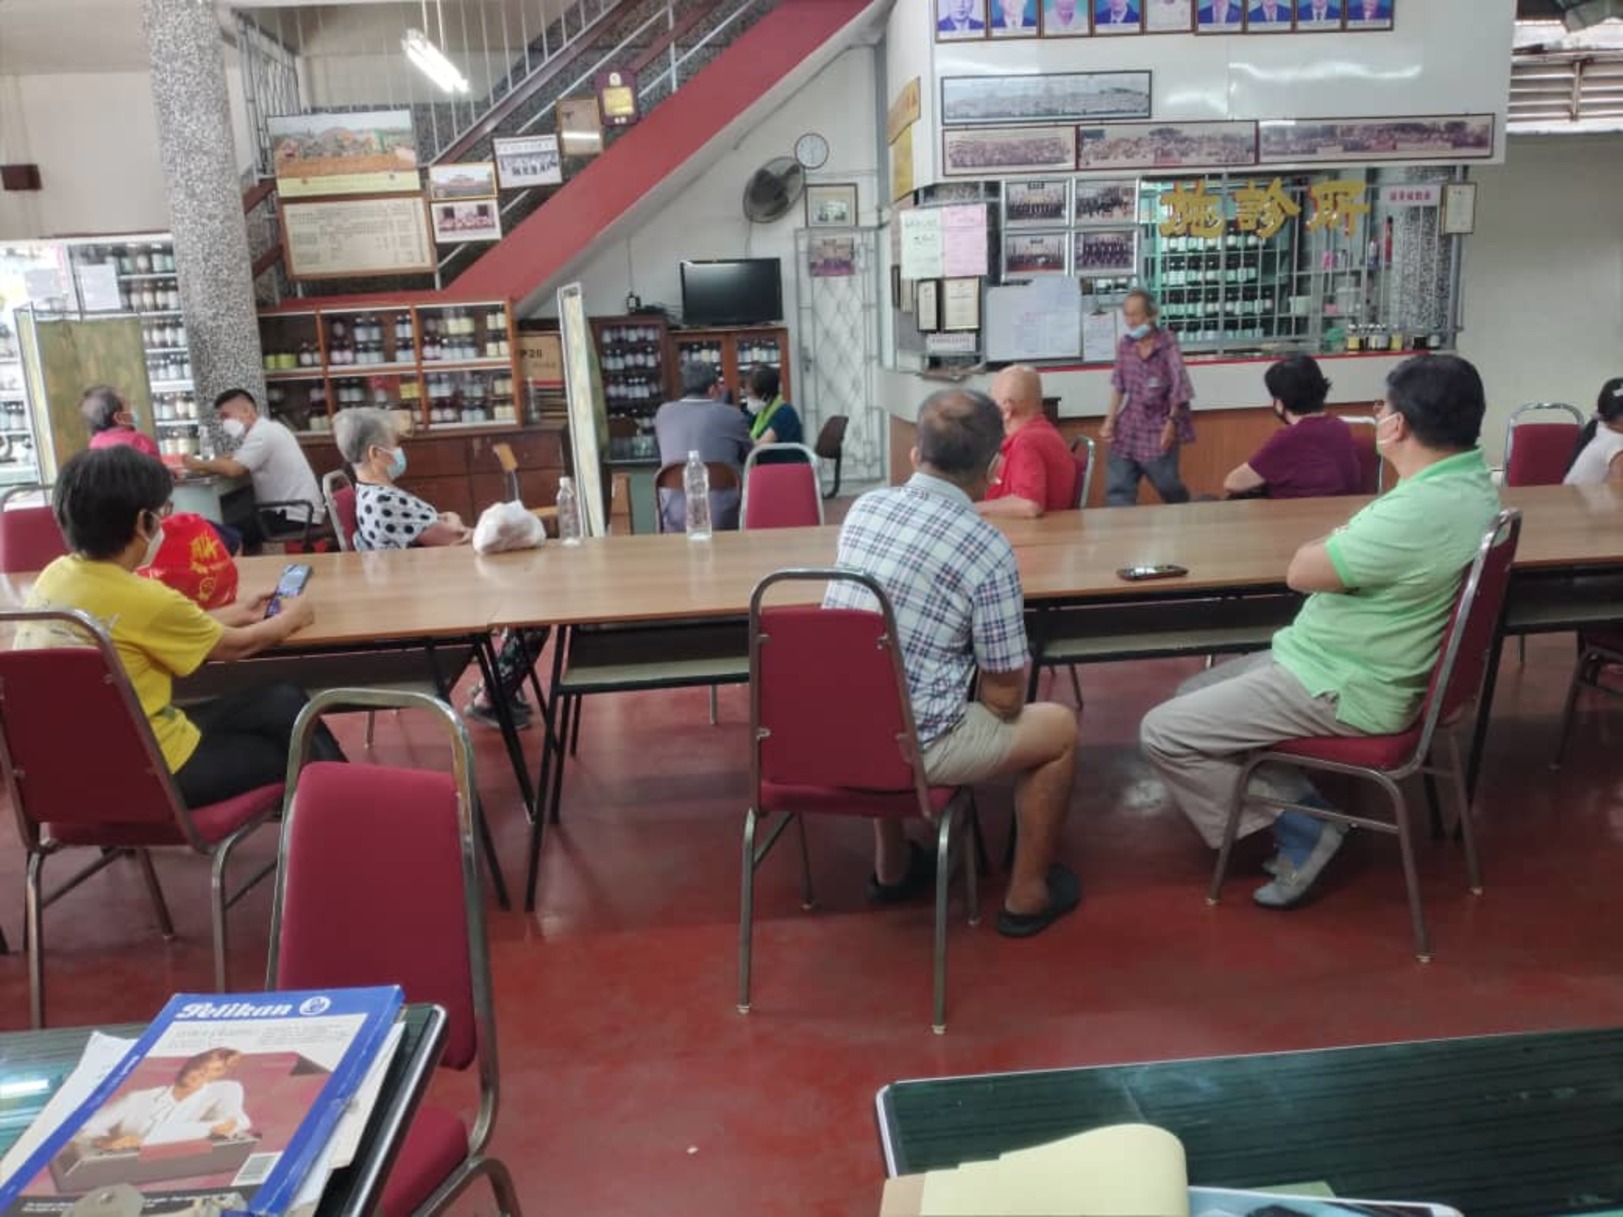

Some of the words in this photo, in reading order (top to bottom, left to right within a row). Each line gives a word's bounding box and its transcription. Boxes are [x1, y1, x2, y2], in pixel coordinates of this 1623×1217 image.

[1159, 177, 1370, 238] 施診所
[175, 1002, 293, 1019] Pelikan
